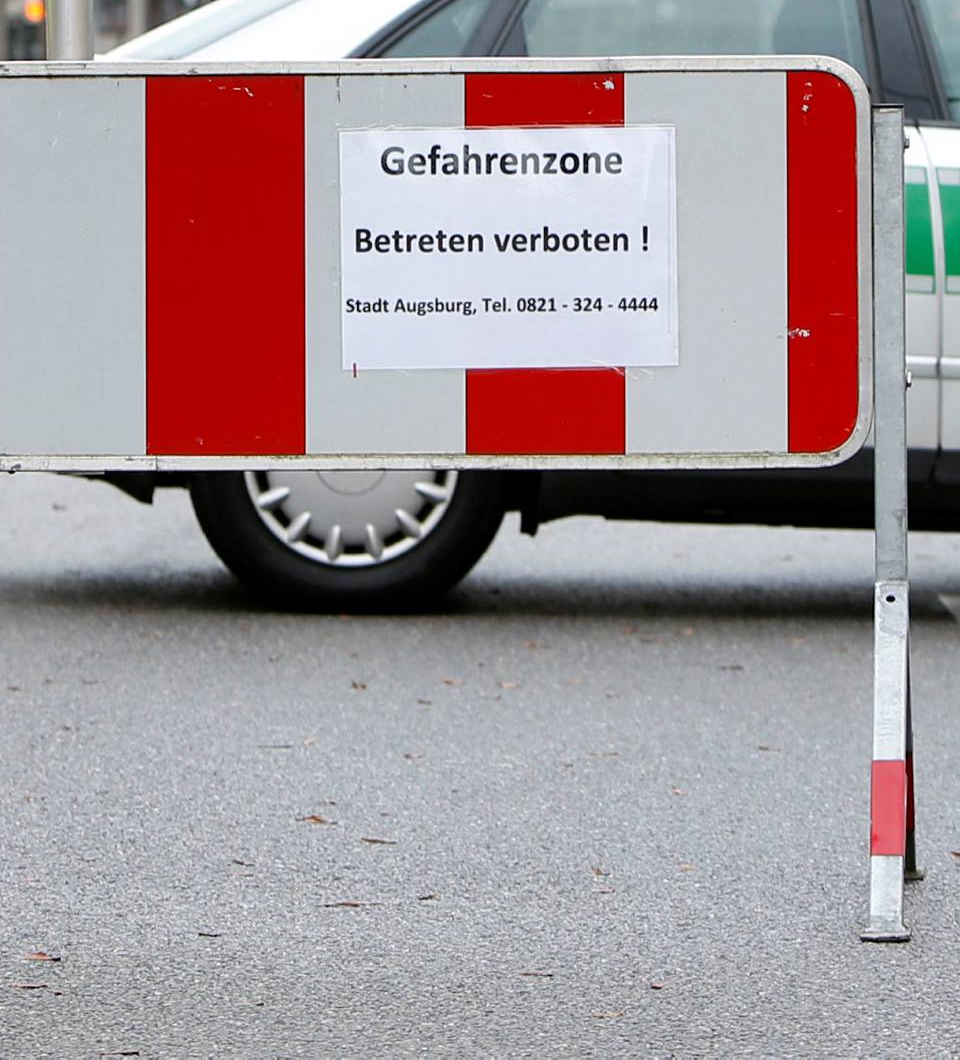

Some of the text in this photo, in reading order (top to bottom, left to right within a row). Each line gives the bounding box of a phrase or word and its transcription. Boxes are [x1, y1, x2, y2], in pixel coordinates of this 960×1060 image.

[380, 143, 623, 176] Gefahrenzone
[355, 225, 650, 254] Betreten verboten !
[345, 297, 390, 314] Stadt
[393, 297, 477, 317] Augsburg,
[481, 296, 512, 313] Tel.
[516, 297, 558, 313] 0821
[572, 296, 604, 313] 324
[617, 297, 659, 312] 4444
